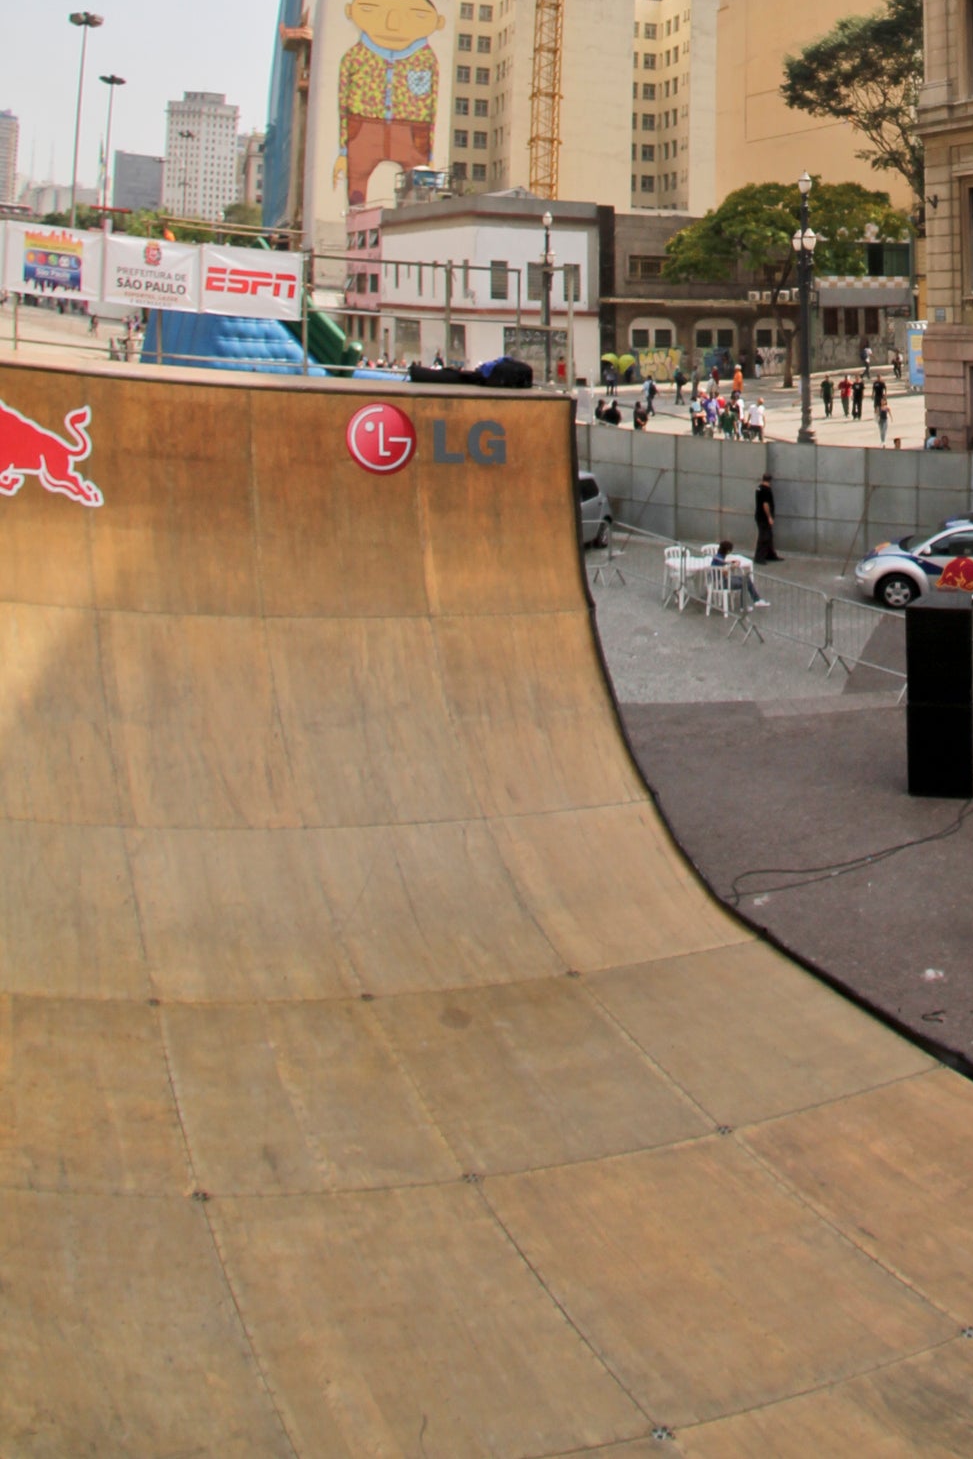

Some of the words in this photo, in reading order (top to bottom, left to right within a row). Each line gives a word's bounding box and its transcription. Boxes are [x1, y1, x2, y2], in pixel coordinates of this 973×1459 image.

[117, 266, 172, 280] PREFEITURA
[174, 272, 187, 281] DE
[117, 275, 143, 290] SÃO
[145, 280, 187, 295] PAULO
[205, 266, 297, 299] ESPN
[433, 420, 507, 465] LG
